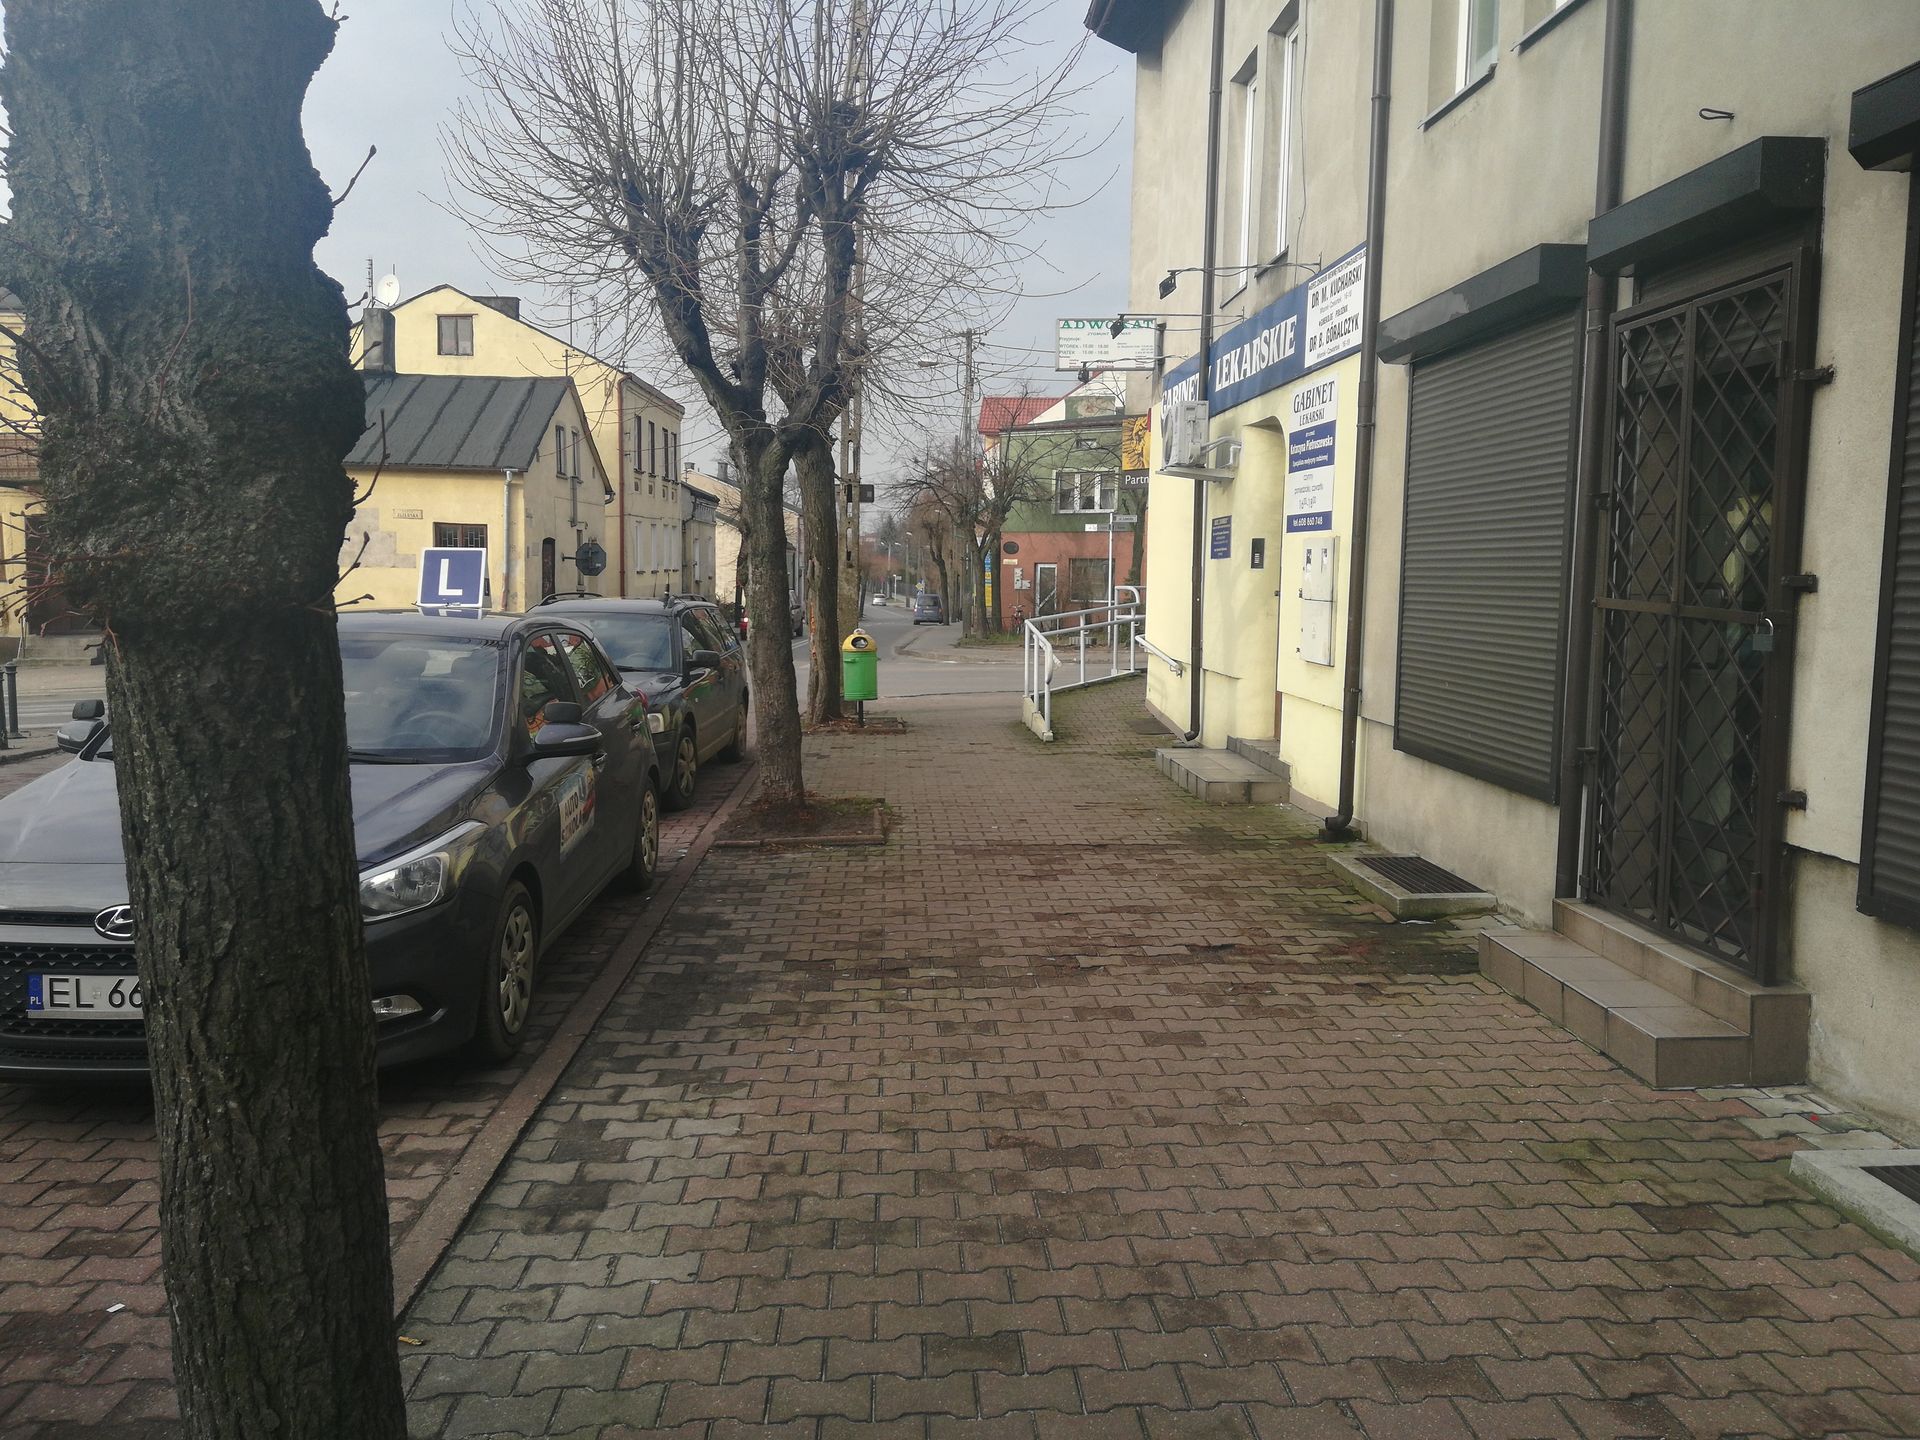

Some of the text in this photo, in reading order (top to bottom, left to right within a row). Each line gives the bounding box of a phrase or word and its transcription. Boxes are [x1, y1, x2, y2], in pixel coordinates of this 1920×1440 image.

[1311, 291, 1320, 309] DR
[1321, 286, 1329, 303] M.
[1330, 263, 1362, 298] KUCHARSKI
[1309, 335, 1318, 352] DR
[1326, 313, 1359, 345] GÓRALCZYK
[1215, 315, 1298, 393] LEKARSKIE
[1293, 381, 1336, 413] GABINET
[1300, 408, 1325, 426] LEKARSKI
[438, 559, 463, 596] L
[564, 791, 579, 820] AUTO
[30, 996, 42, 1005] PL
